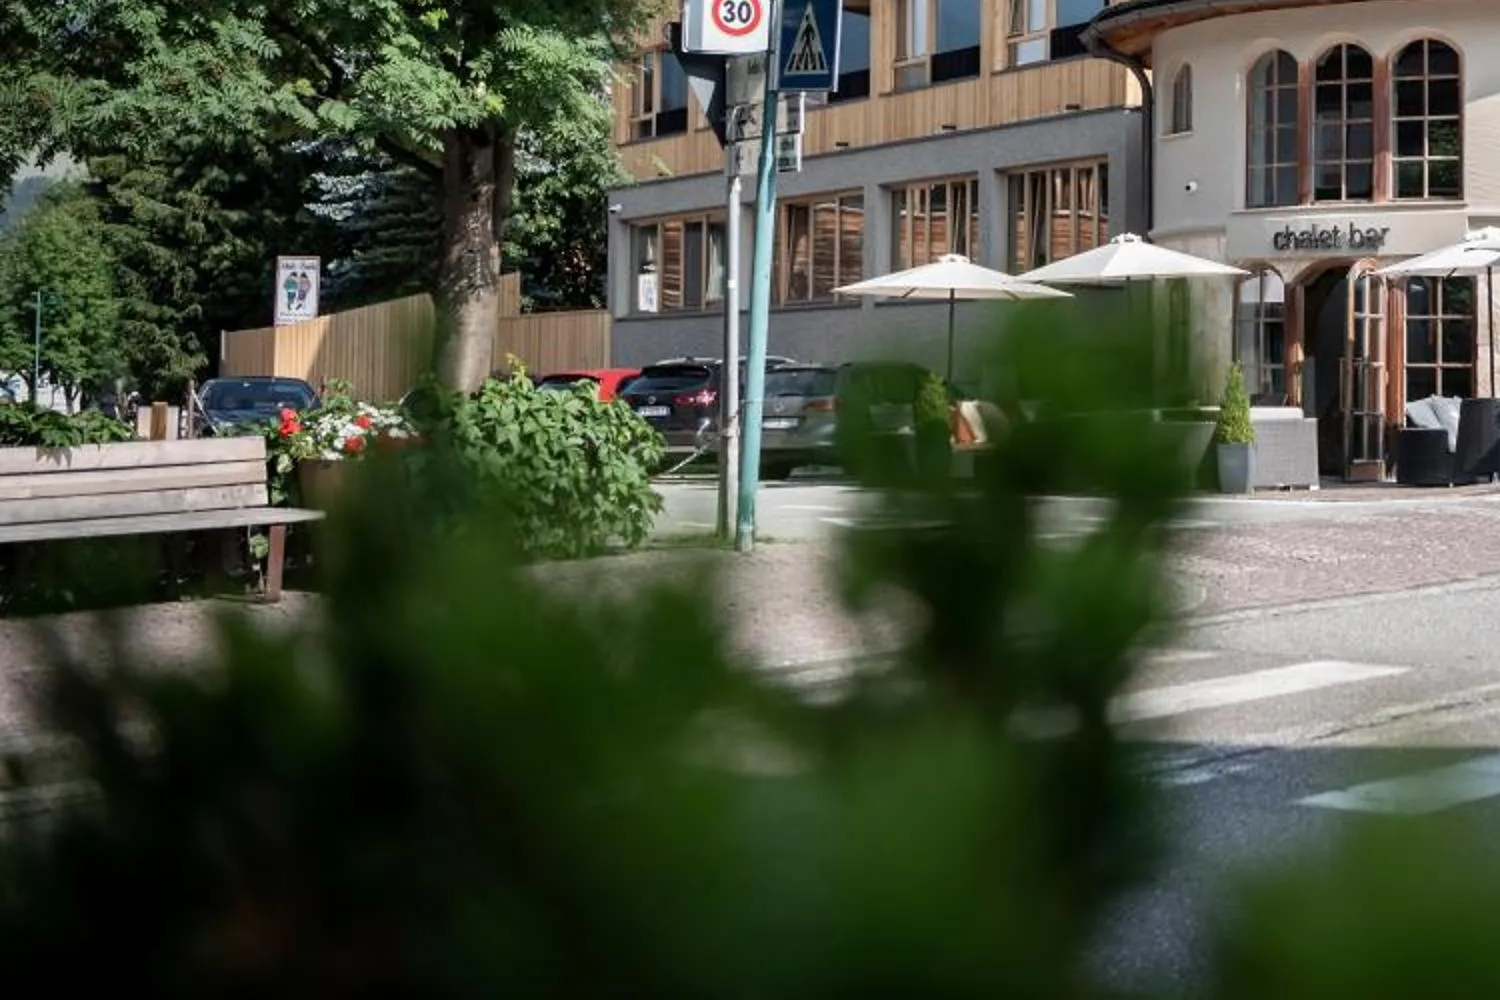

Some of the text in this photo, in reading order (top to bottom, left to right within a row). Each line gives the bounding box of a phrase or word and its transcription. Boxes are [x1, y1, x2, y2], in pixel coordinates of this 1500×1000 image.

[722, 0, 752, 24] 30
[1273, 221, 1391, 251] chalet bar
